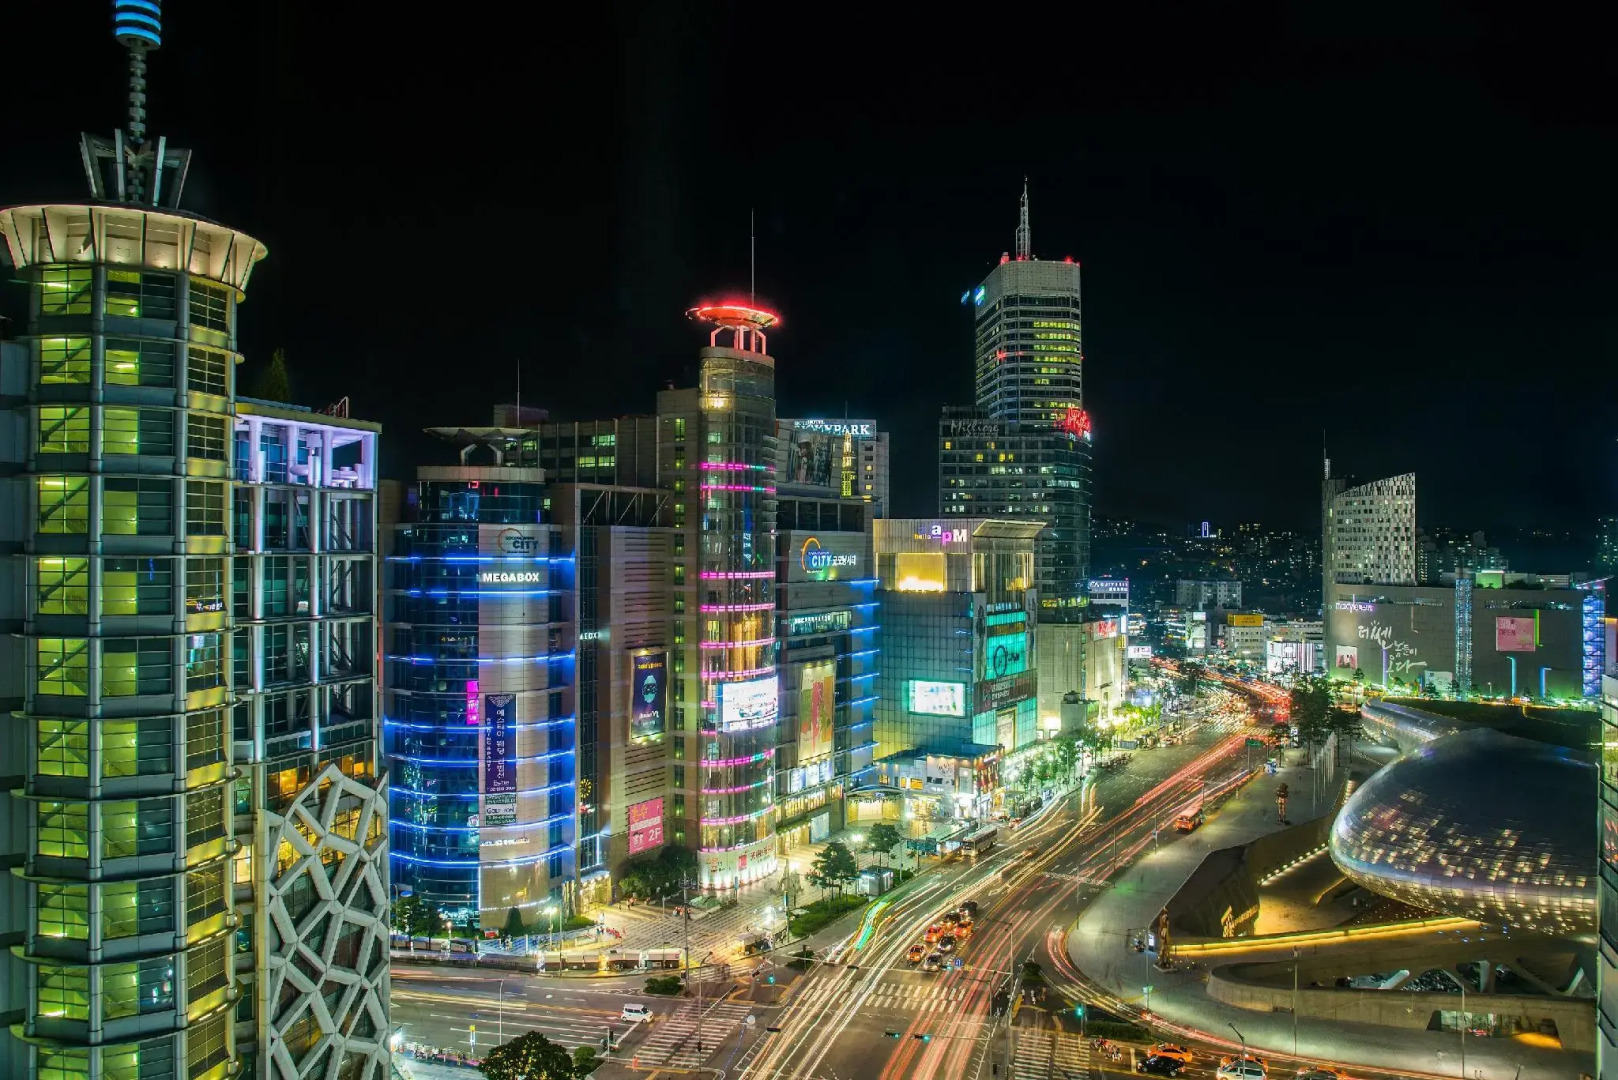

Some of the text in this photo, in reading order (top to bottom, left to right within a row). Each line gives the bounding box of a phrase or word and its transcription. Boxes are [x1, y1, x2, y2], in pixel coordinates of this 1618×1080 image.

[513, 541, 539, 550] CITY
[812, 555, 832, 566] CITY
[482, 572, 540, 582] MEGABOX
[1386, 655, 1428, 680] 온다
[649, 827, 661, 842] 2F
